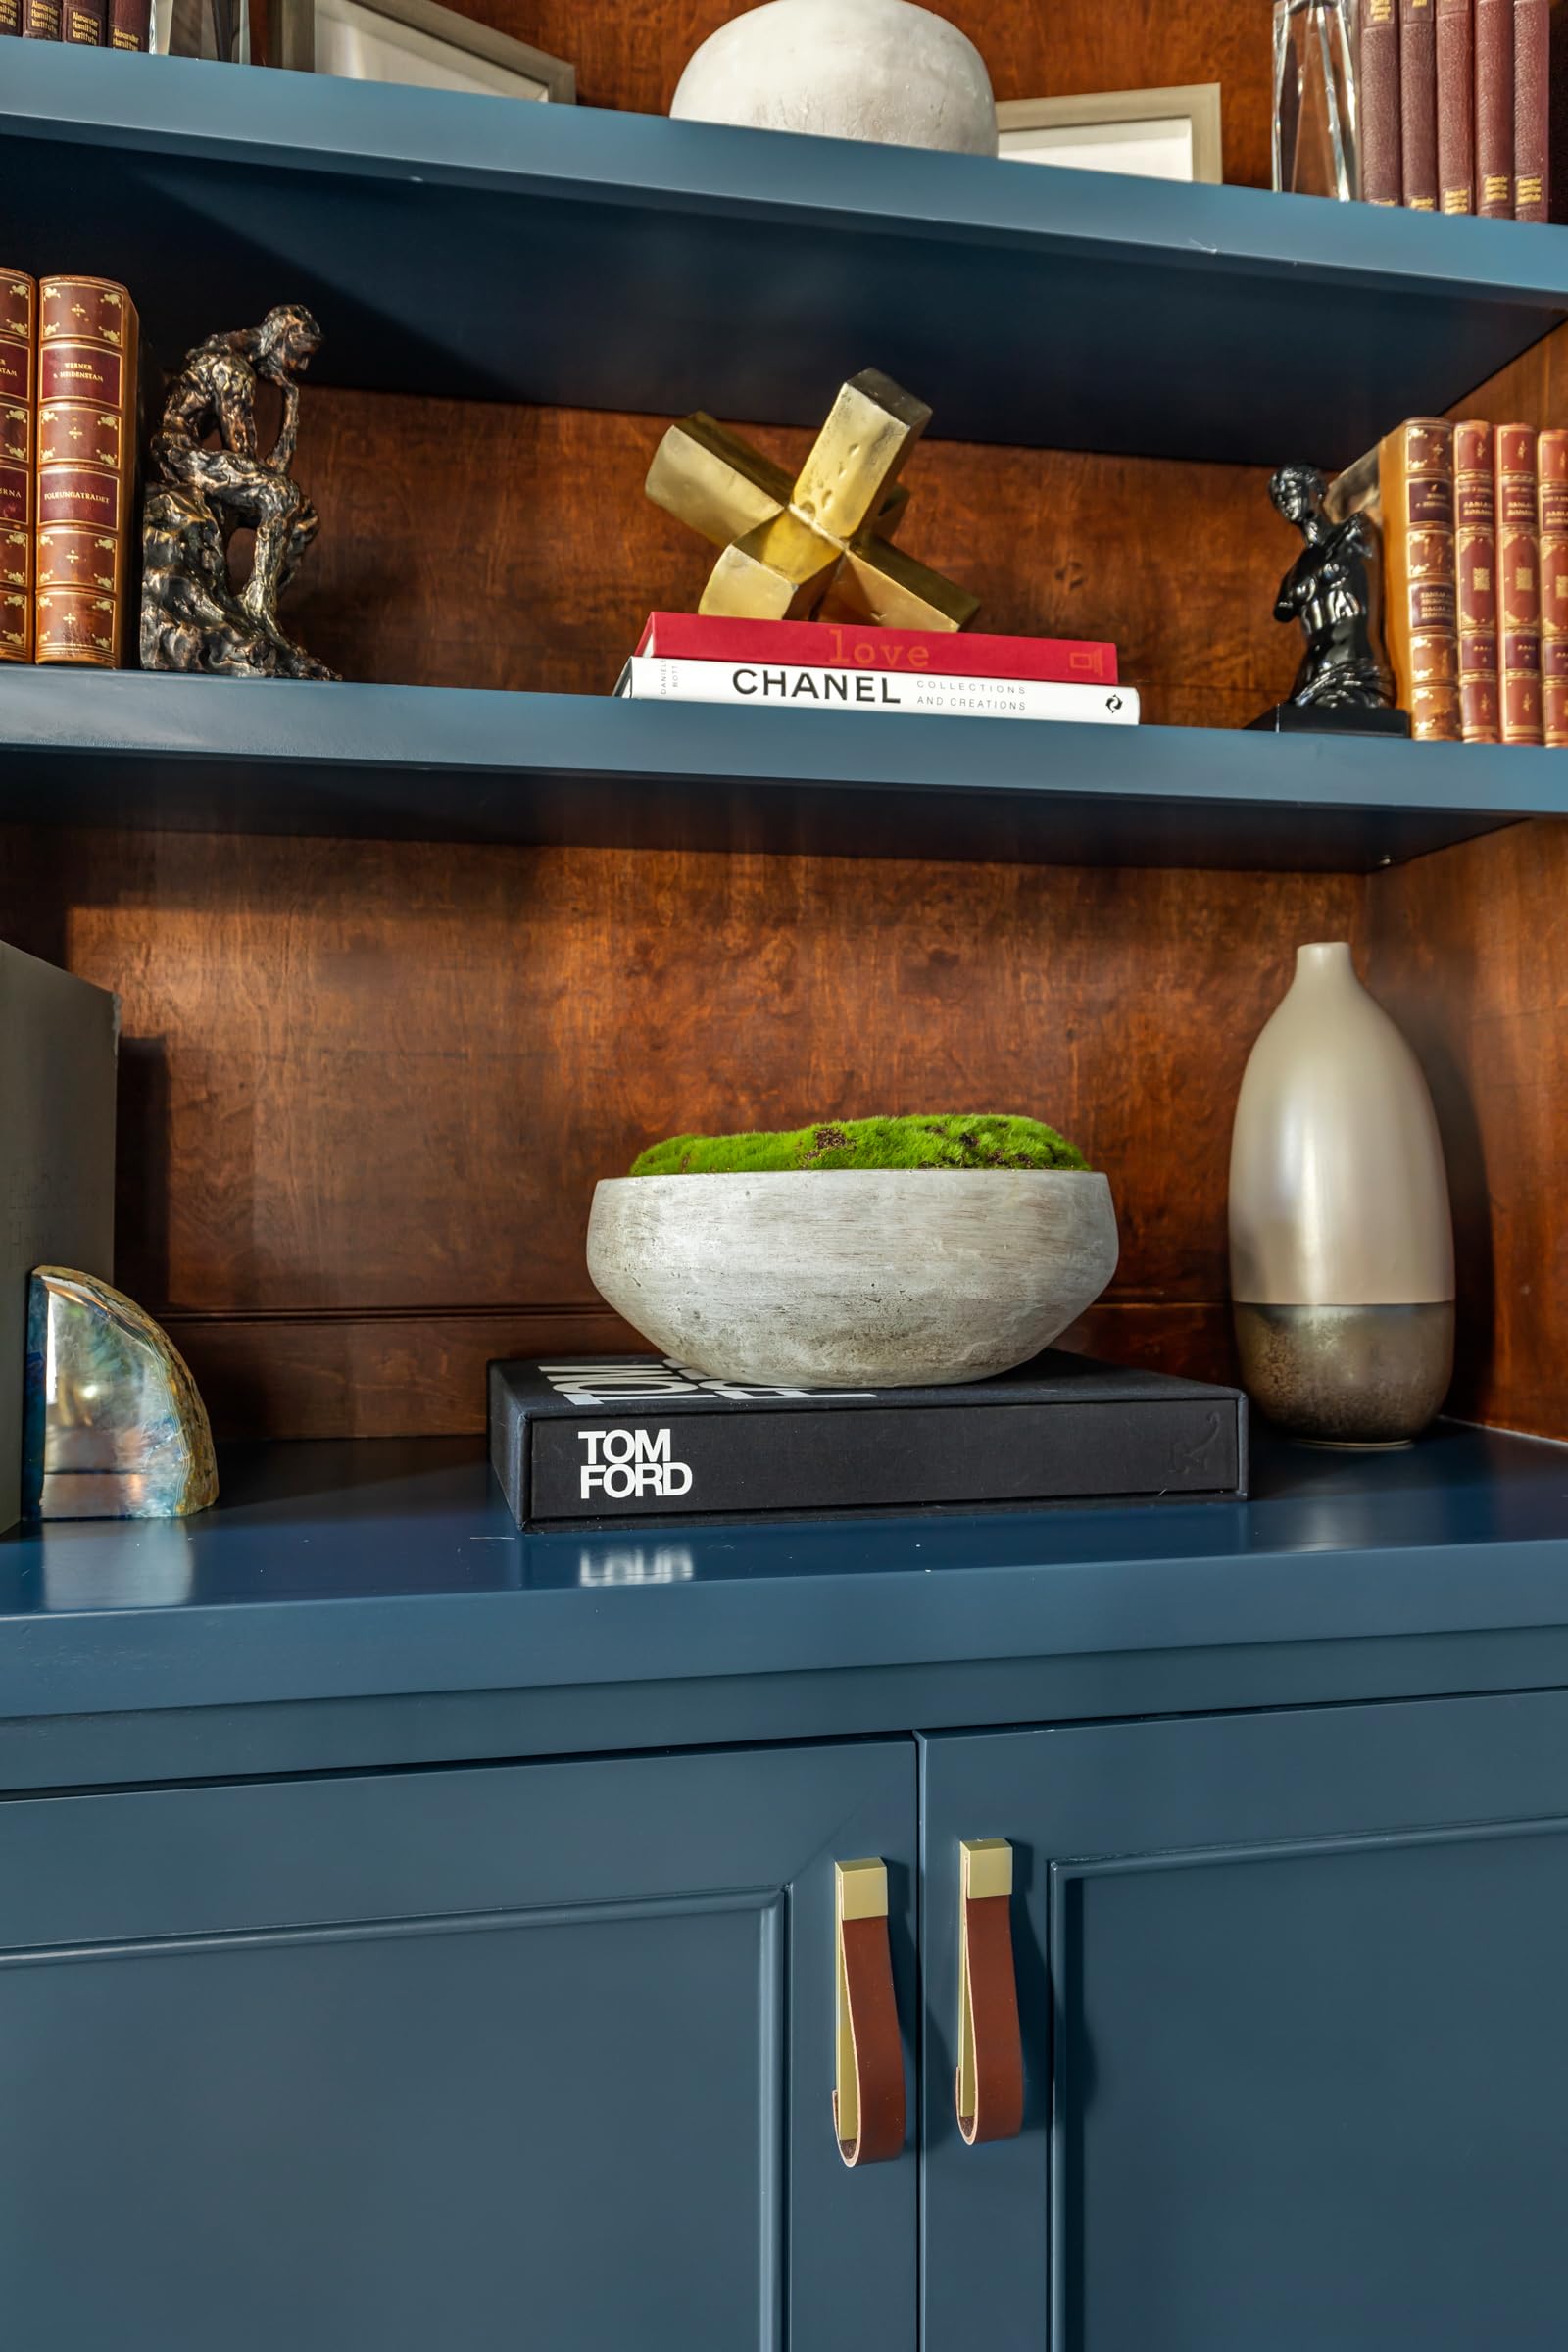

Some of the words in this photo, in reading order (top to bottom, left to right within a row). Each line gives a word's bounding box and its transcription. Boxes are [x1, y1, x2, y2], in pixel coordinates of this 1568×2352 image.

[73, 11, 99, 27] Alexander
[829, 629, 930, 667] love
[732, 668, 901, 704] CHANEL
[916, 680, 1026, 695] COLLECTIONS
[917, 696, 944, 706] AND
[950, 698, 1026, 710] CREATIONS
[577, 1428, 671, 1465] TOM
[580, 1461, 693, 1499] FORD
